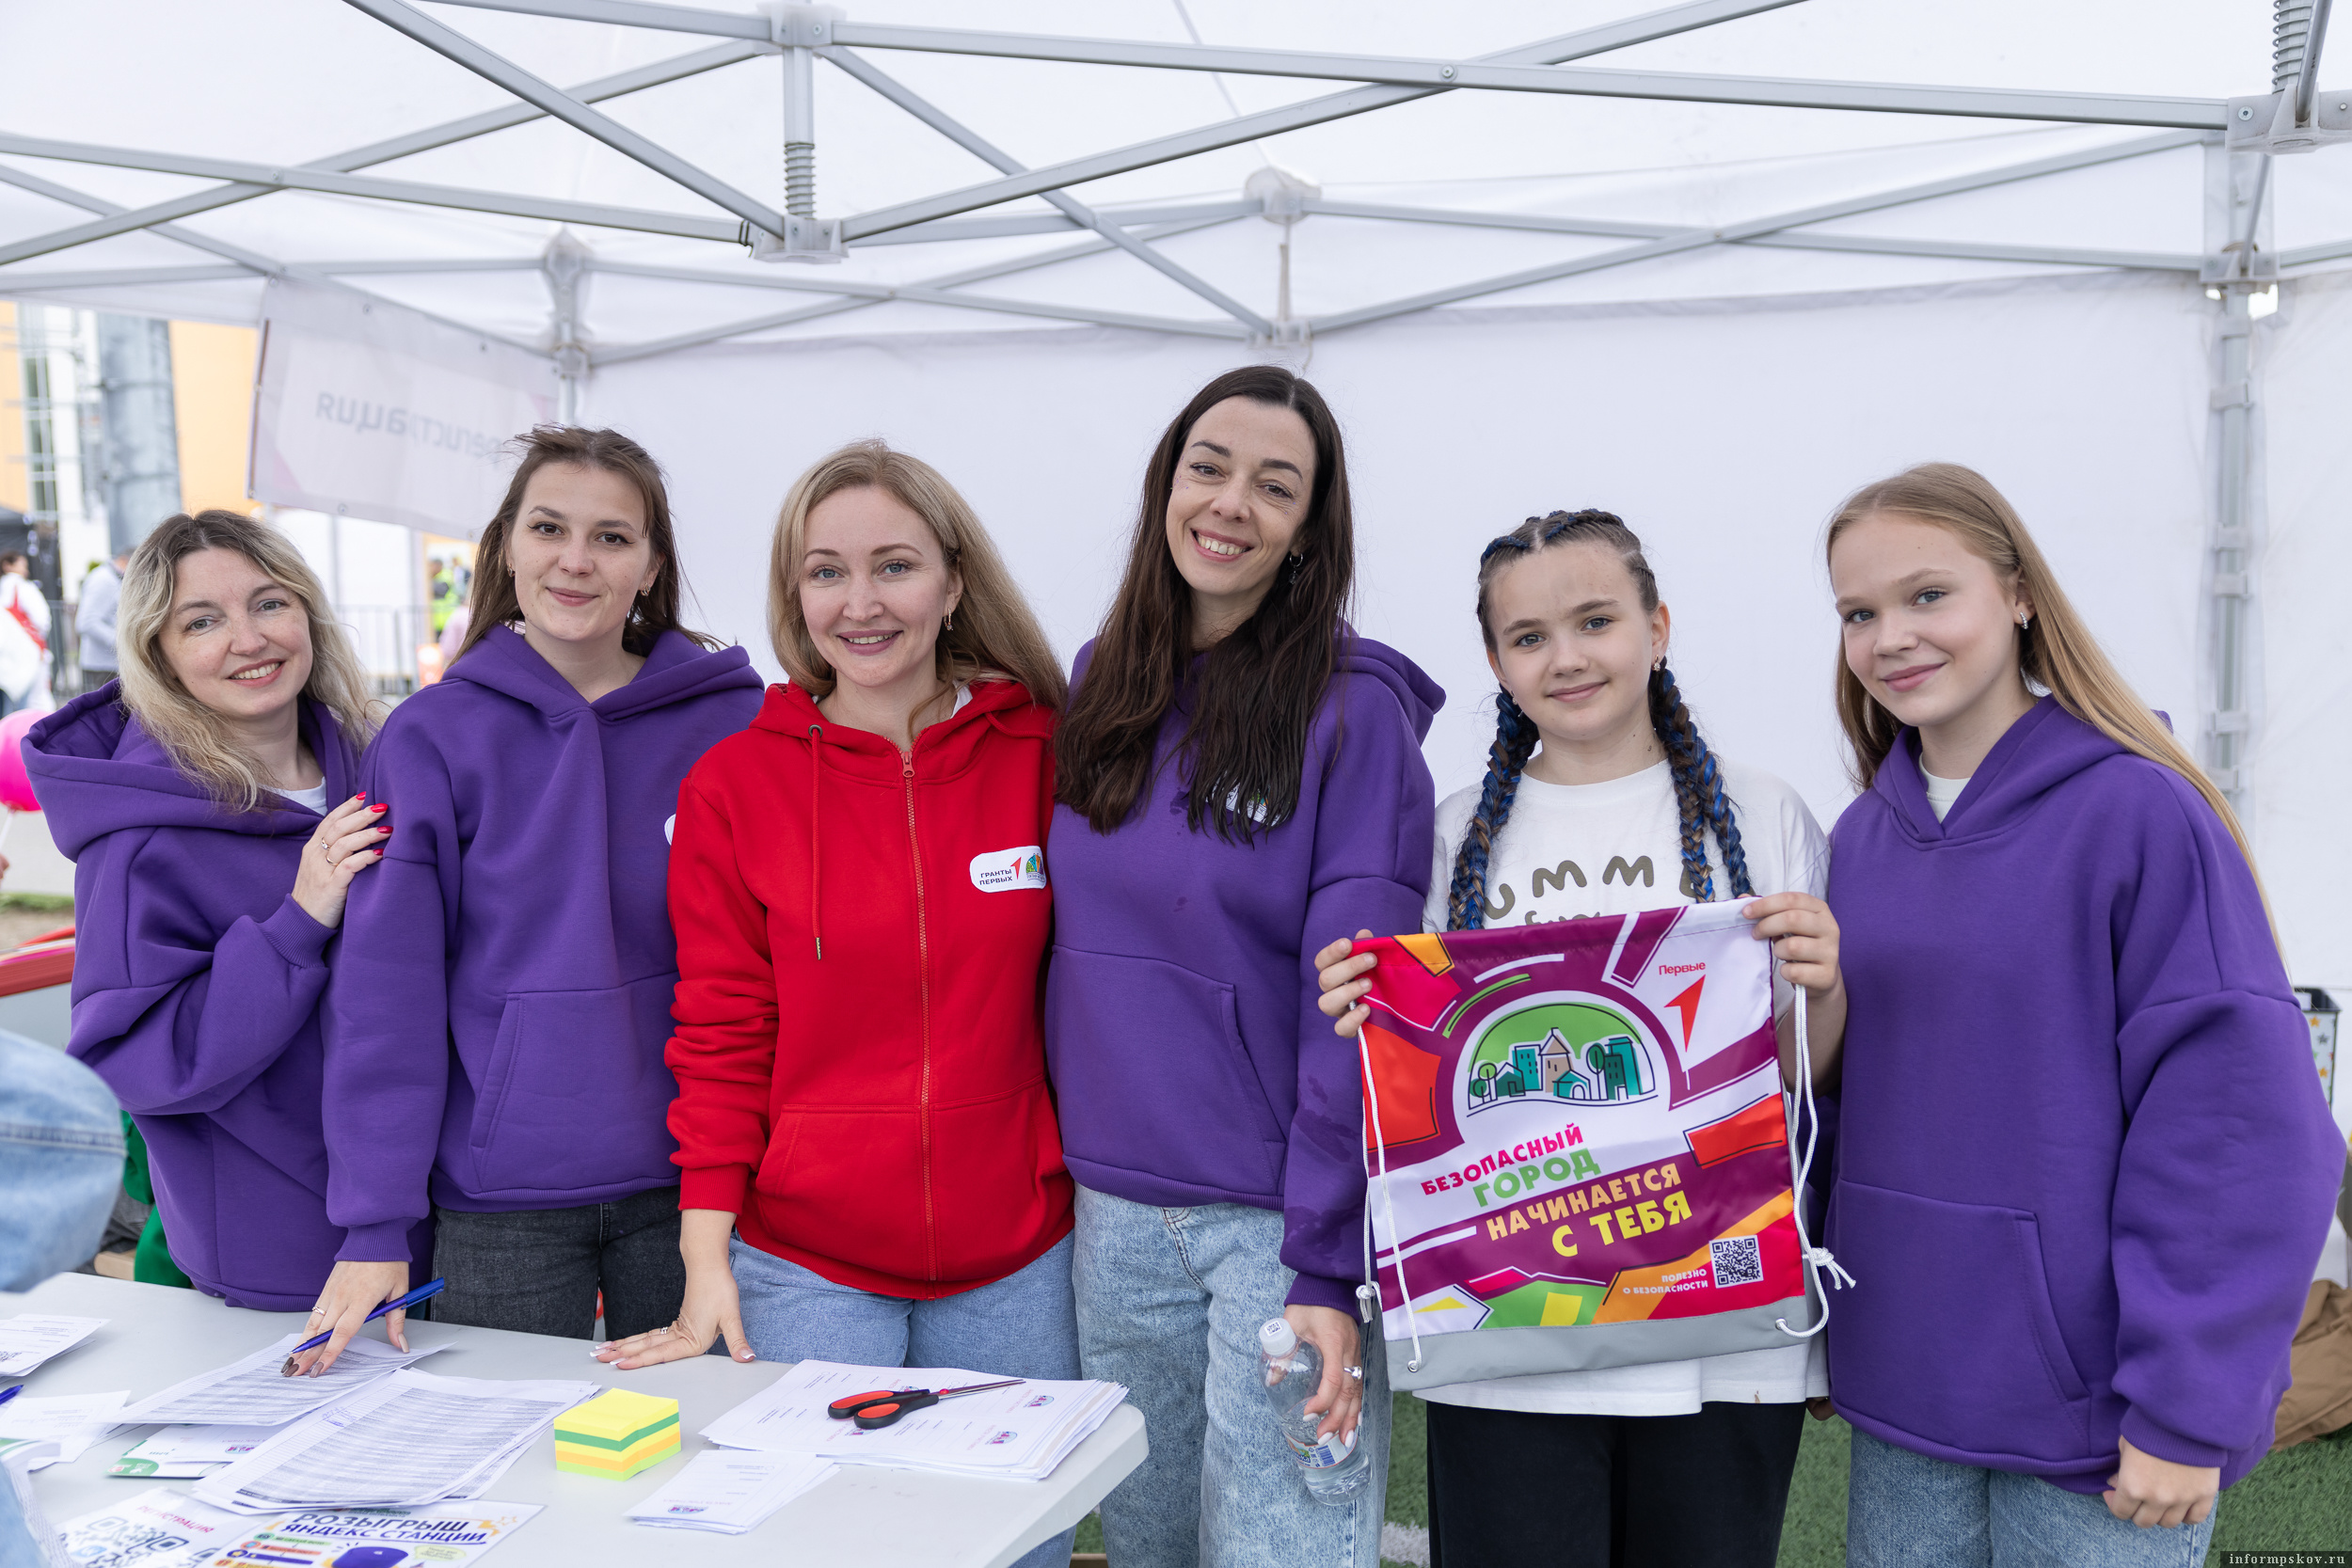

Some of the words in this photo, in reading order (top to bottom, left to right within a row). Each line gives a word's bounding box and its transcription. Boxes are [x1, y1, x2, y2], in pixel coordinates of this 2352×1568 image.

[979, 876, 1013, 885] ПЕРВЫХ
[980, 868, 1012, 879] ГРАНТЫ
[1659, 961, 1707, 976] Первые
[1421, 1122, 1584, 1196] БЕЗОПАСНЫЙ
[1472, 1148, 1602, 1208] ГОРОД
[1486, 1163, 1682, 1241] НАЧИНАЕТСЯ
[1552, 1225, 1578, 1258] С
[1589, 1190, 1692, 1246] ТЕБЯ
[1661, 1268, 1708, 1283] ПОЛЕЗНО
[1633, 1280, 1708, 1294] БЕЗОПАСНОСТИ
[293, 1513, 470, 1532] РОЗЫГРЫШ
[282, 1524, 378, 1538] ЯНДЕКС
[380, 1529, 488, 1544] СТАНЦИИ
